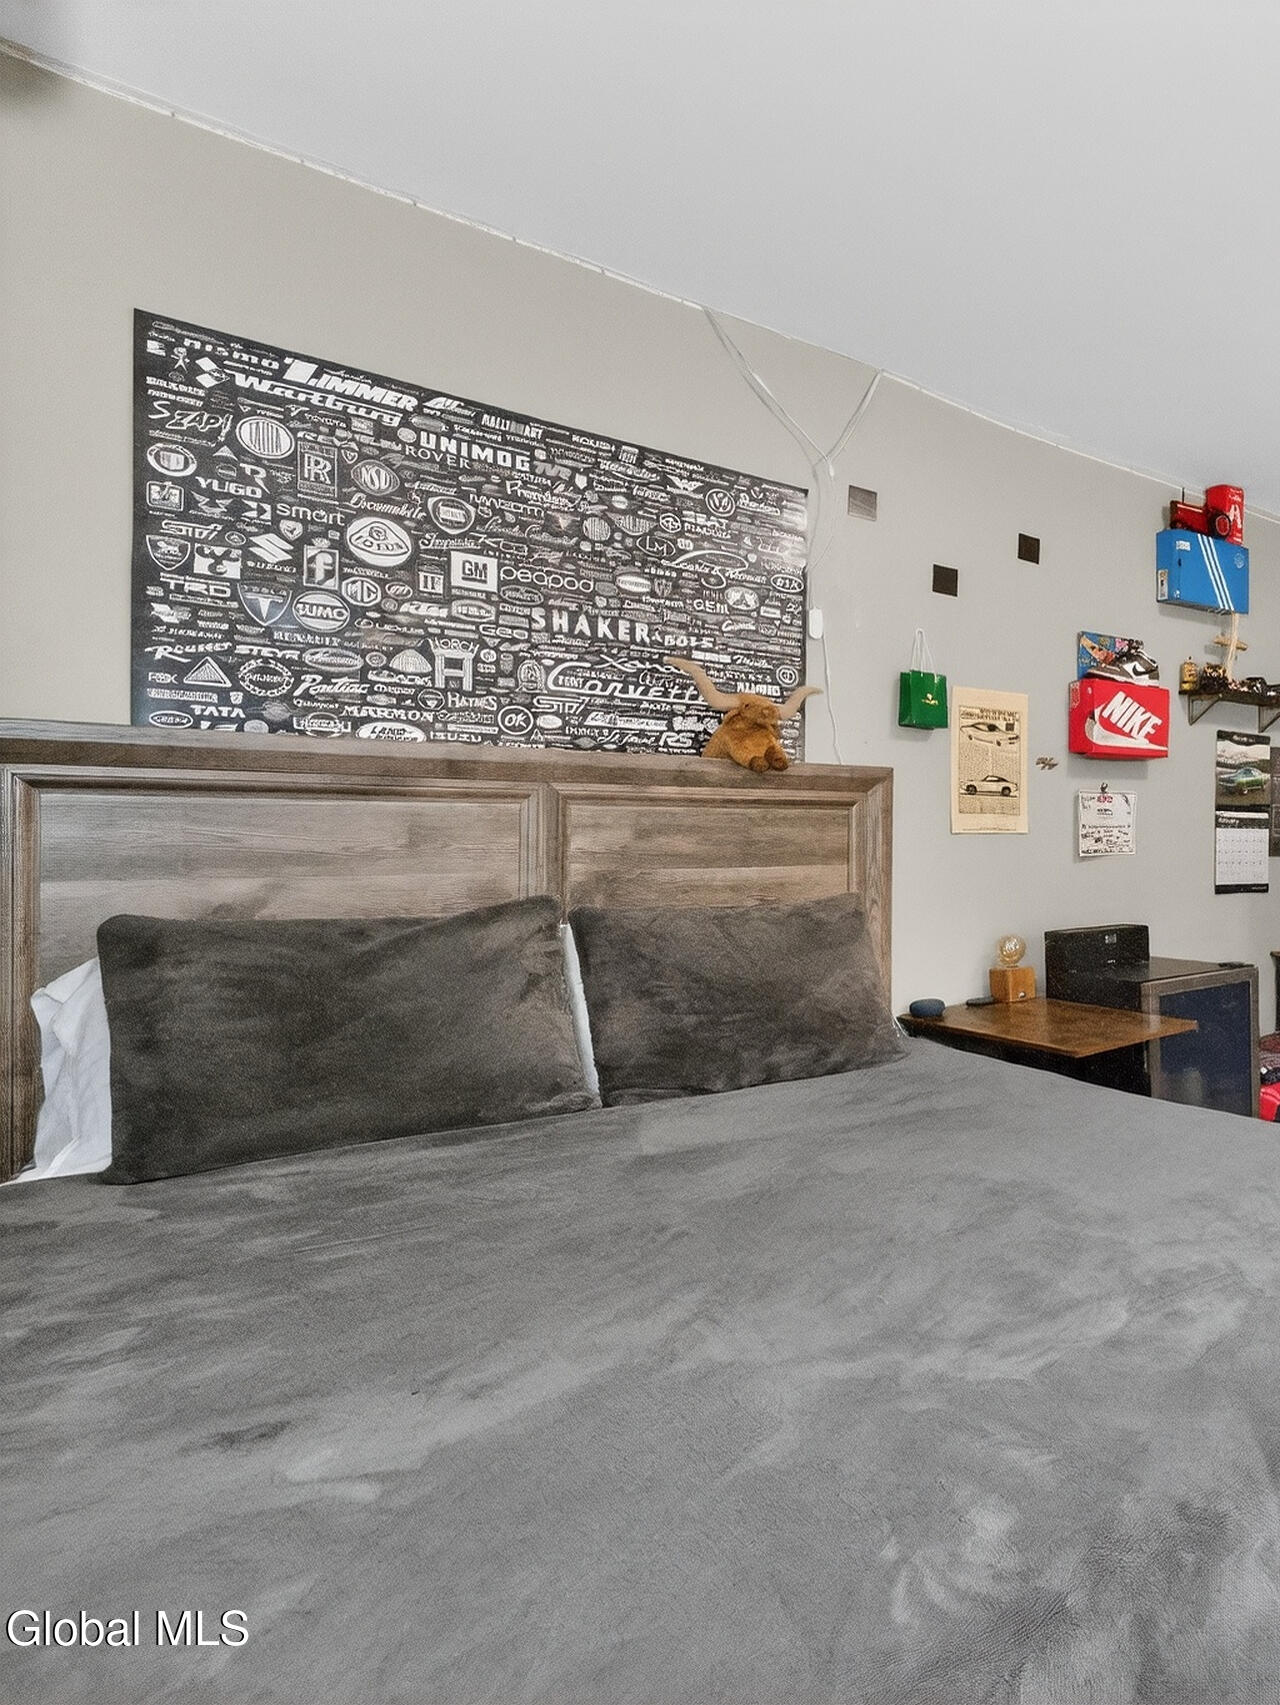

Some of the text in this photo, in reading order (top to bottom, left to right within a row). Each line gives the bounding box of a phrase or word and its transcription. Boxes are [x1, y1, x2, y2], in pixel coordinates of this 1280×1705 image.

[405, 444, 471, 470] ROVER
[420, 431, 531, 472] UNIMOG
[276, 503, 345, 526] smart
[461, 559, 489, 584] GM
[531, 607, 651, 645] SHAKER
[190, 704, 247, 718] TATA
[1101, 690, 1163, 741] NIKE
